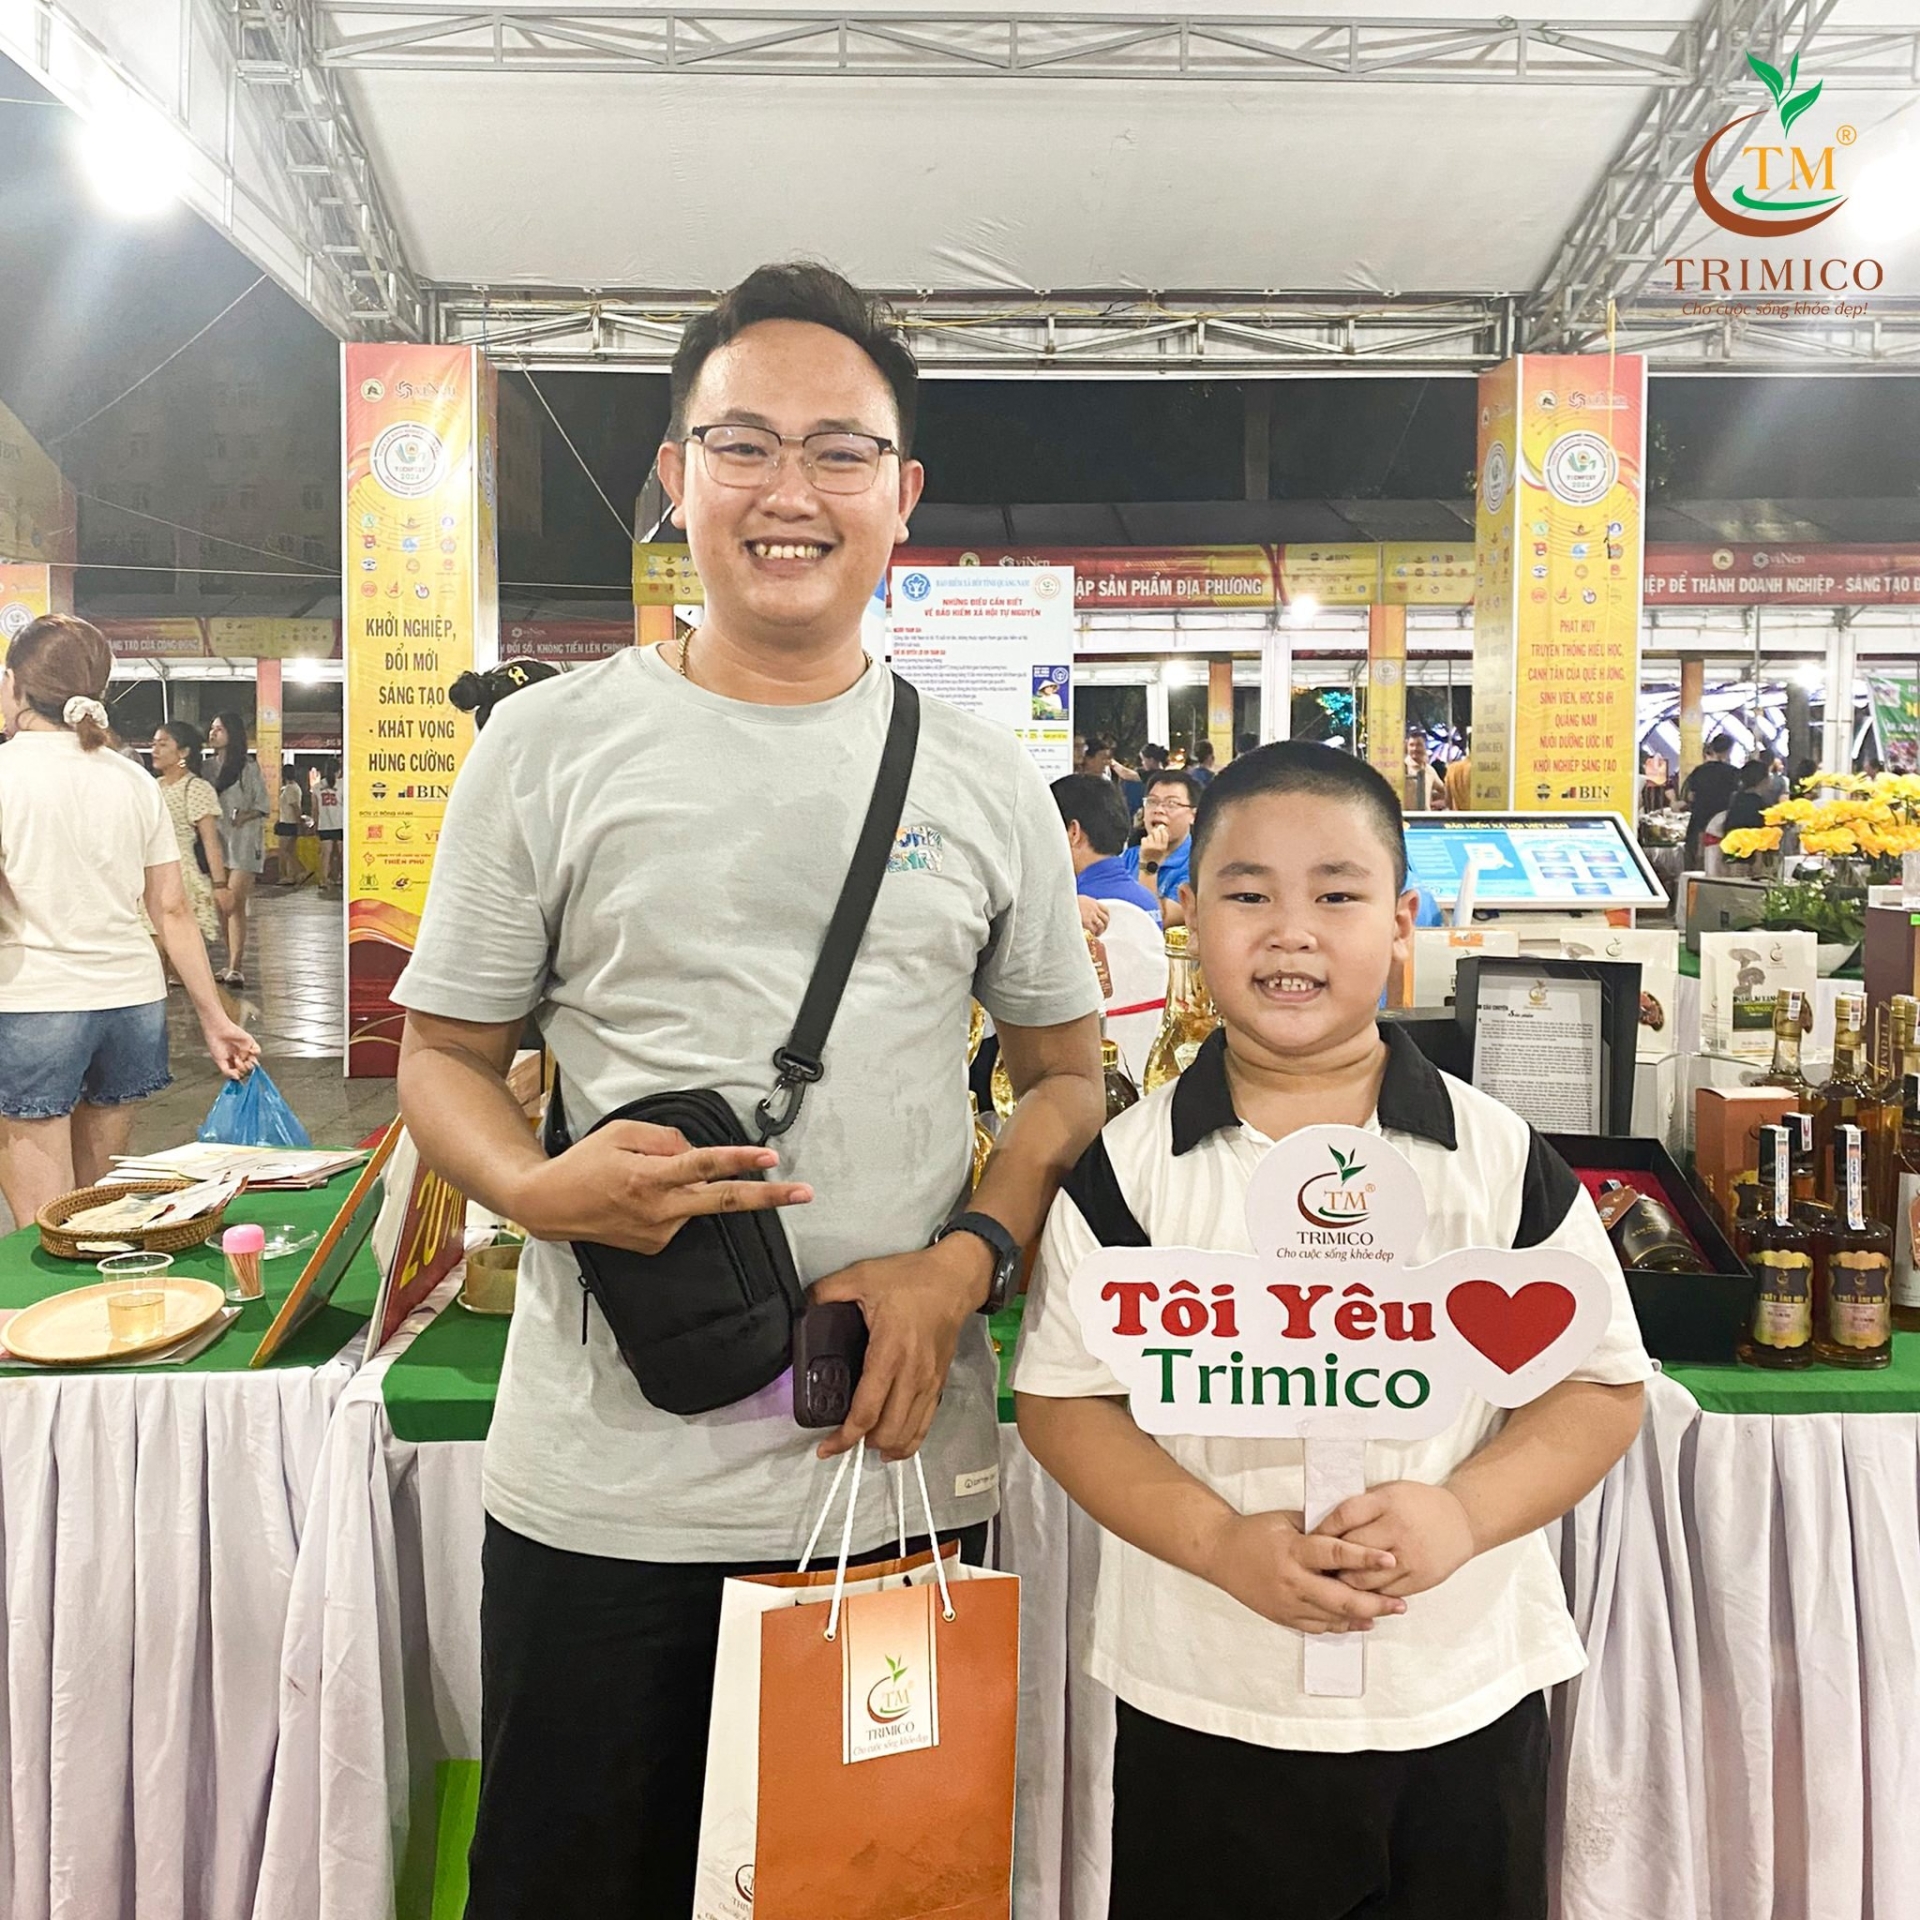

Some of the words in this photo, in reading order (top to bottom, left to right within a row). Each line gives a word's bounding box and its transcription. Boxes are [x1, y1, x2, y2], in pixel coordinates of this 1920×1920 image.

[1098, 573, 1127, 597] SẢN
[1131, 571, 1172, 597] PHẨM
[1176, 578, 1200, 600] ĐỊA
[1204, 576, 1263, 596] PHƯƠNG
[1669, 570, 1687, 593] ĐỂ
[1692, 572, 1736, 594] THÀNH
[1739, 577, 1783, 594] DOANH
[1786, 573, 1835, 597] NGHIỆP
[1846, 573, 1881, 593] SÁNG
[1885, 575, 1909, 595] TẠO
[366, 611, 399, 637] KHỞI
[403, 614, 457, 641] NGHIỆP,
[385, 643, 409, 671] ĐỔI
[413, 649, 439, 672] MỚI
[537, 640, 565, 654] KHÔNG
[565, 640, 582, 653] TIẾN
[585, 640, 601, 653] LÊN
[379, 681, 414, 704] SÁNG
[418, 686, 445, 708] TẠO
[378, 715, 414, 738] KHÁT
[419, 719, 455, 743] VỌNG
[369, 748, 406, 772] HÙNG
[410, 748, 455, 772] CƯỜNG
[1296, 1231, 1375, 1246] TRIMICO
[1276, 1247, 1297, 1259] Cho
[1299, 1248, 1322, 1261] cuộc
[1324, 1247, 1348, 1262] sống
[1101, 1280, 1240, 1339] Tôi
[1266, 1282, 1437, 1341] Yêu
[1141, 1348, 1431, 1410] Trimico
[866, 1721, 915, 1741] TRIMICO
